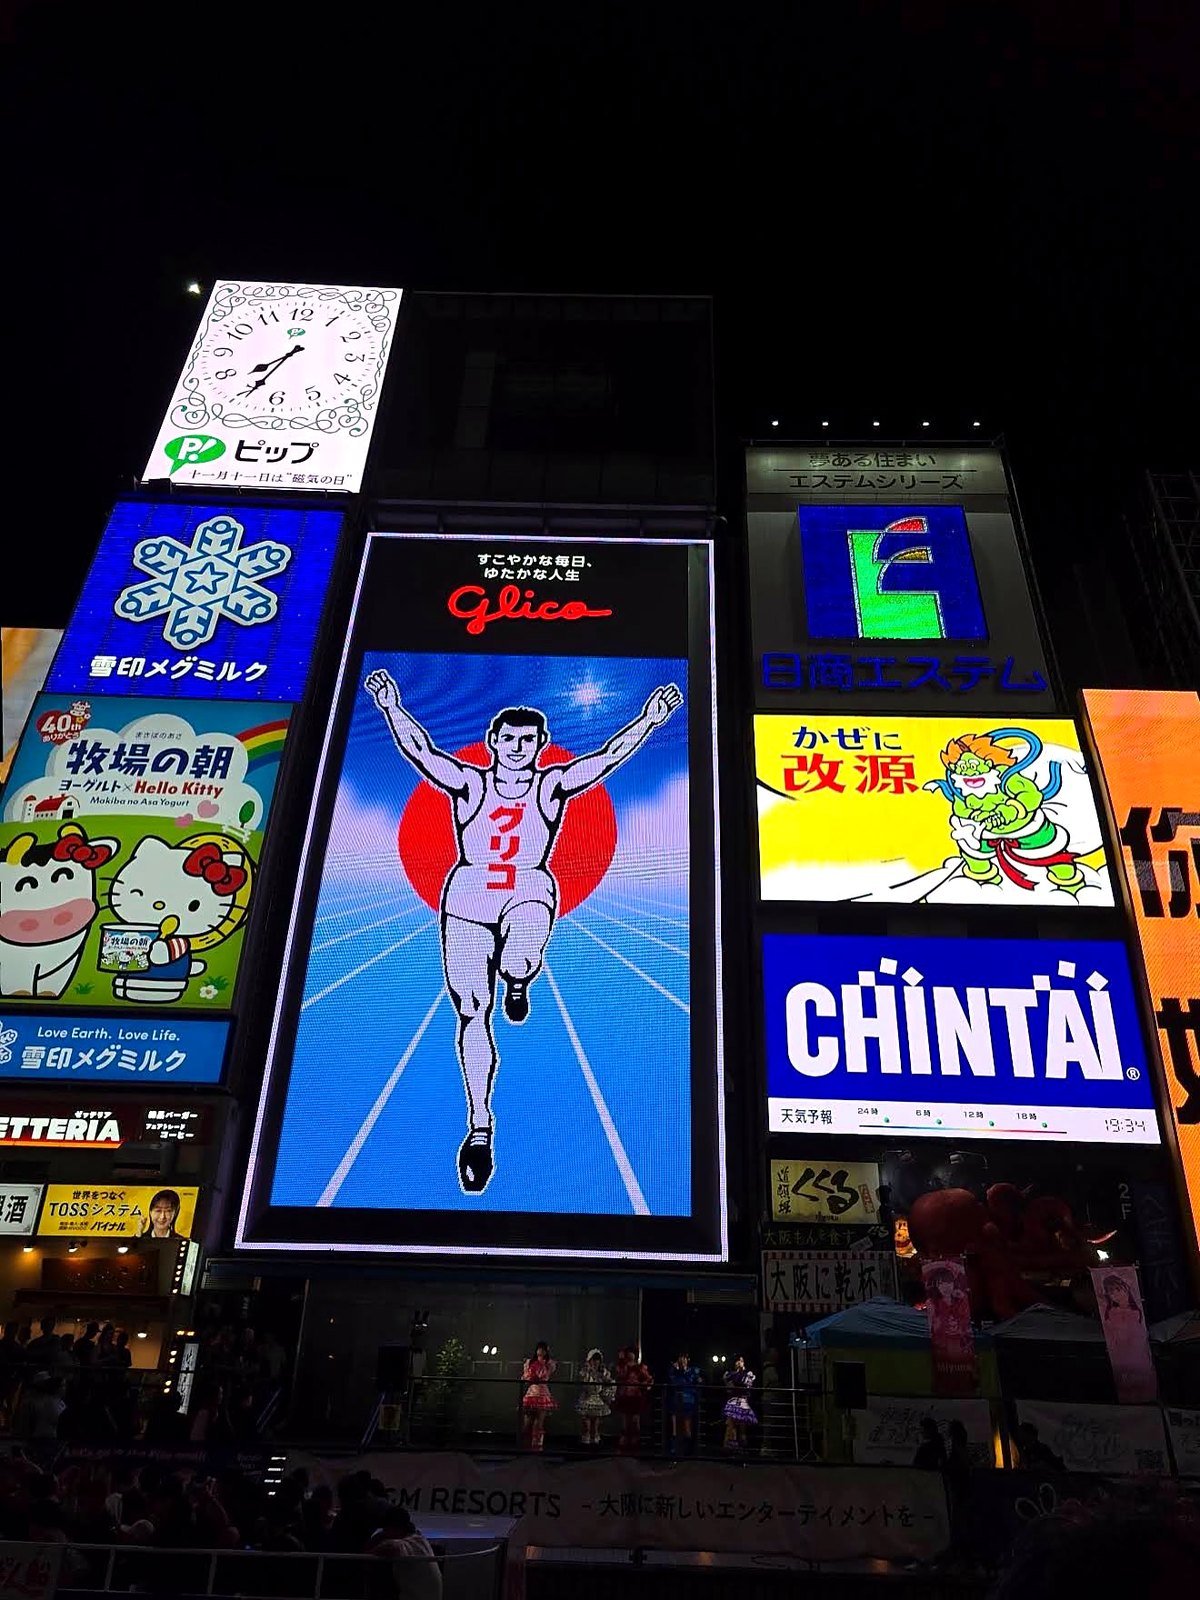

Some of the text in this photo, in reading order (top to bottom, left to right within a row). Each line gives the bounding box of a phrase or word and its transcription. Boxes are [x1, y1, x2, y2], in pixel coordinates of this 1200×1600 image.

[257, 310, 280, 326] 11
[289, 308, 314, 321] 12
[226, 323, 253, 341] 10
[215, 368, 237, 380] 8
[269, 391, 286, 405] 6
[305, 386, 321, 401] 5
[234, 439, 320, 464] ピップ
[808, 452, 937, 468] 夢ある住まい
[788, 473, 964, 490] エステムシリーズ
[477, 553, 593, 568] すこやかな毎日、
[483, 567, 581, 582] ゆたかな人生
[448, 584, 613, 635] Glico
[89, 654, 268, 682] 雪印メグミルク
[761, 652, 1049, 692] 日商エステム
[792, 726, 902, 751] かぜに
[66, 739, 235, 780] 牧場の朝
[781, 752, 920, 795] 改源
[134, 779, 178, 795] Hello
[182, 780, 225, 799] Kitty
[90, 796, 126, 805] Makiba
[140, 798, 159, 806] Asa
[160, 798, 190, 808] Yogurt
[486, 802, 527, 890] グリコ
[38, 1026, 181, 1042] Love Earth. Love Life.
[21, 1043, 187, 1073] 雪印メグミルク
[780, 1108, 833, 1125] 天気予報
[1104, 1118, 1146, 1133] 19:34
[160, 1131, 195, 1140] コーヒー
[72, 1190, 127, 1201] 世界をつなぐ
[792, 1167, 860, 1215] くくる
[0, 1195, 30, 1224] 酒
[770, 1261, 878, 1302] 大阪に乾杯
[430, 1487, 562, 1519] RESORTS
